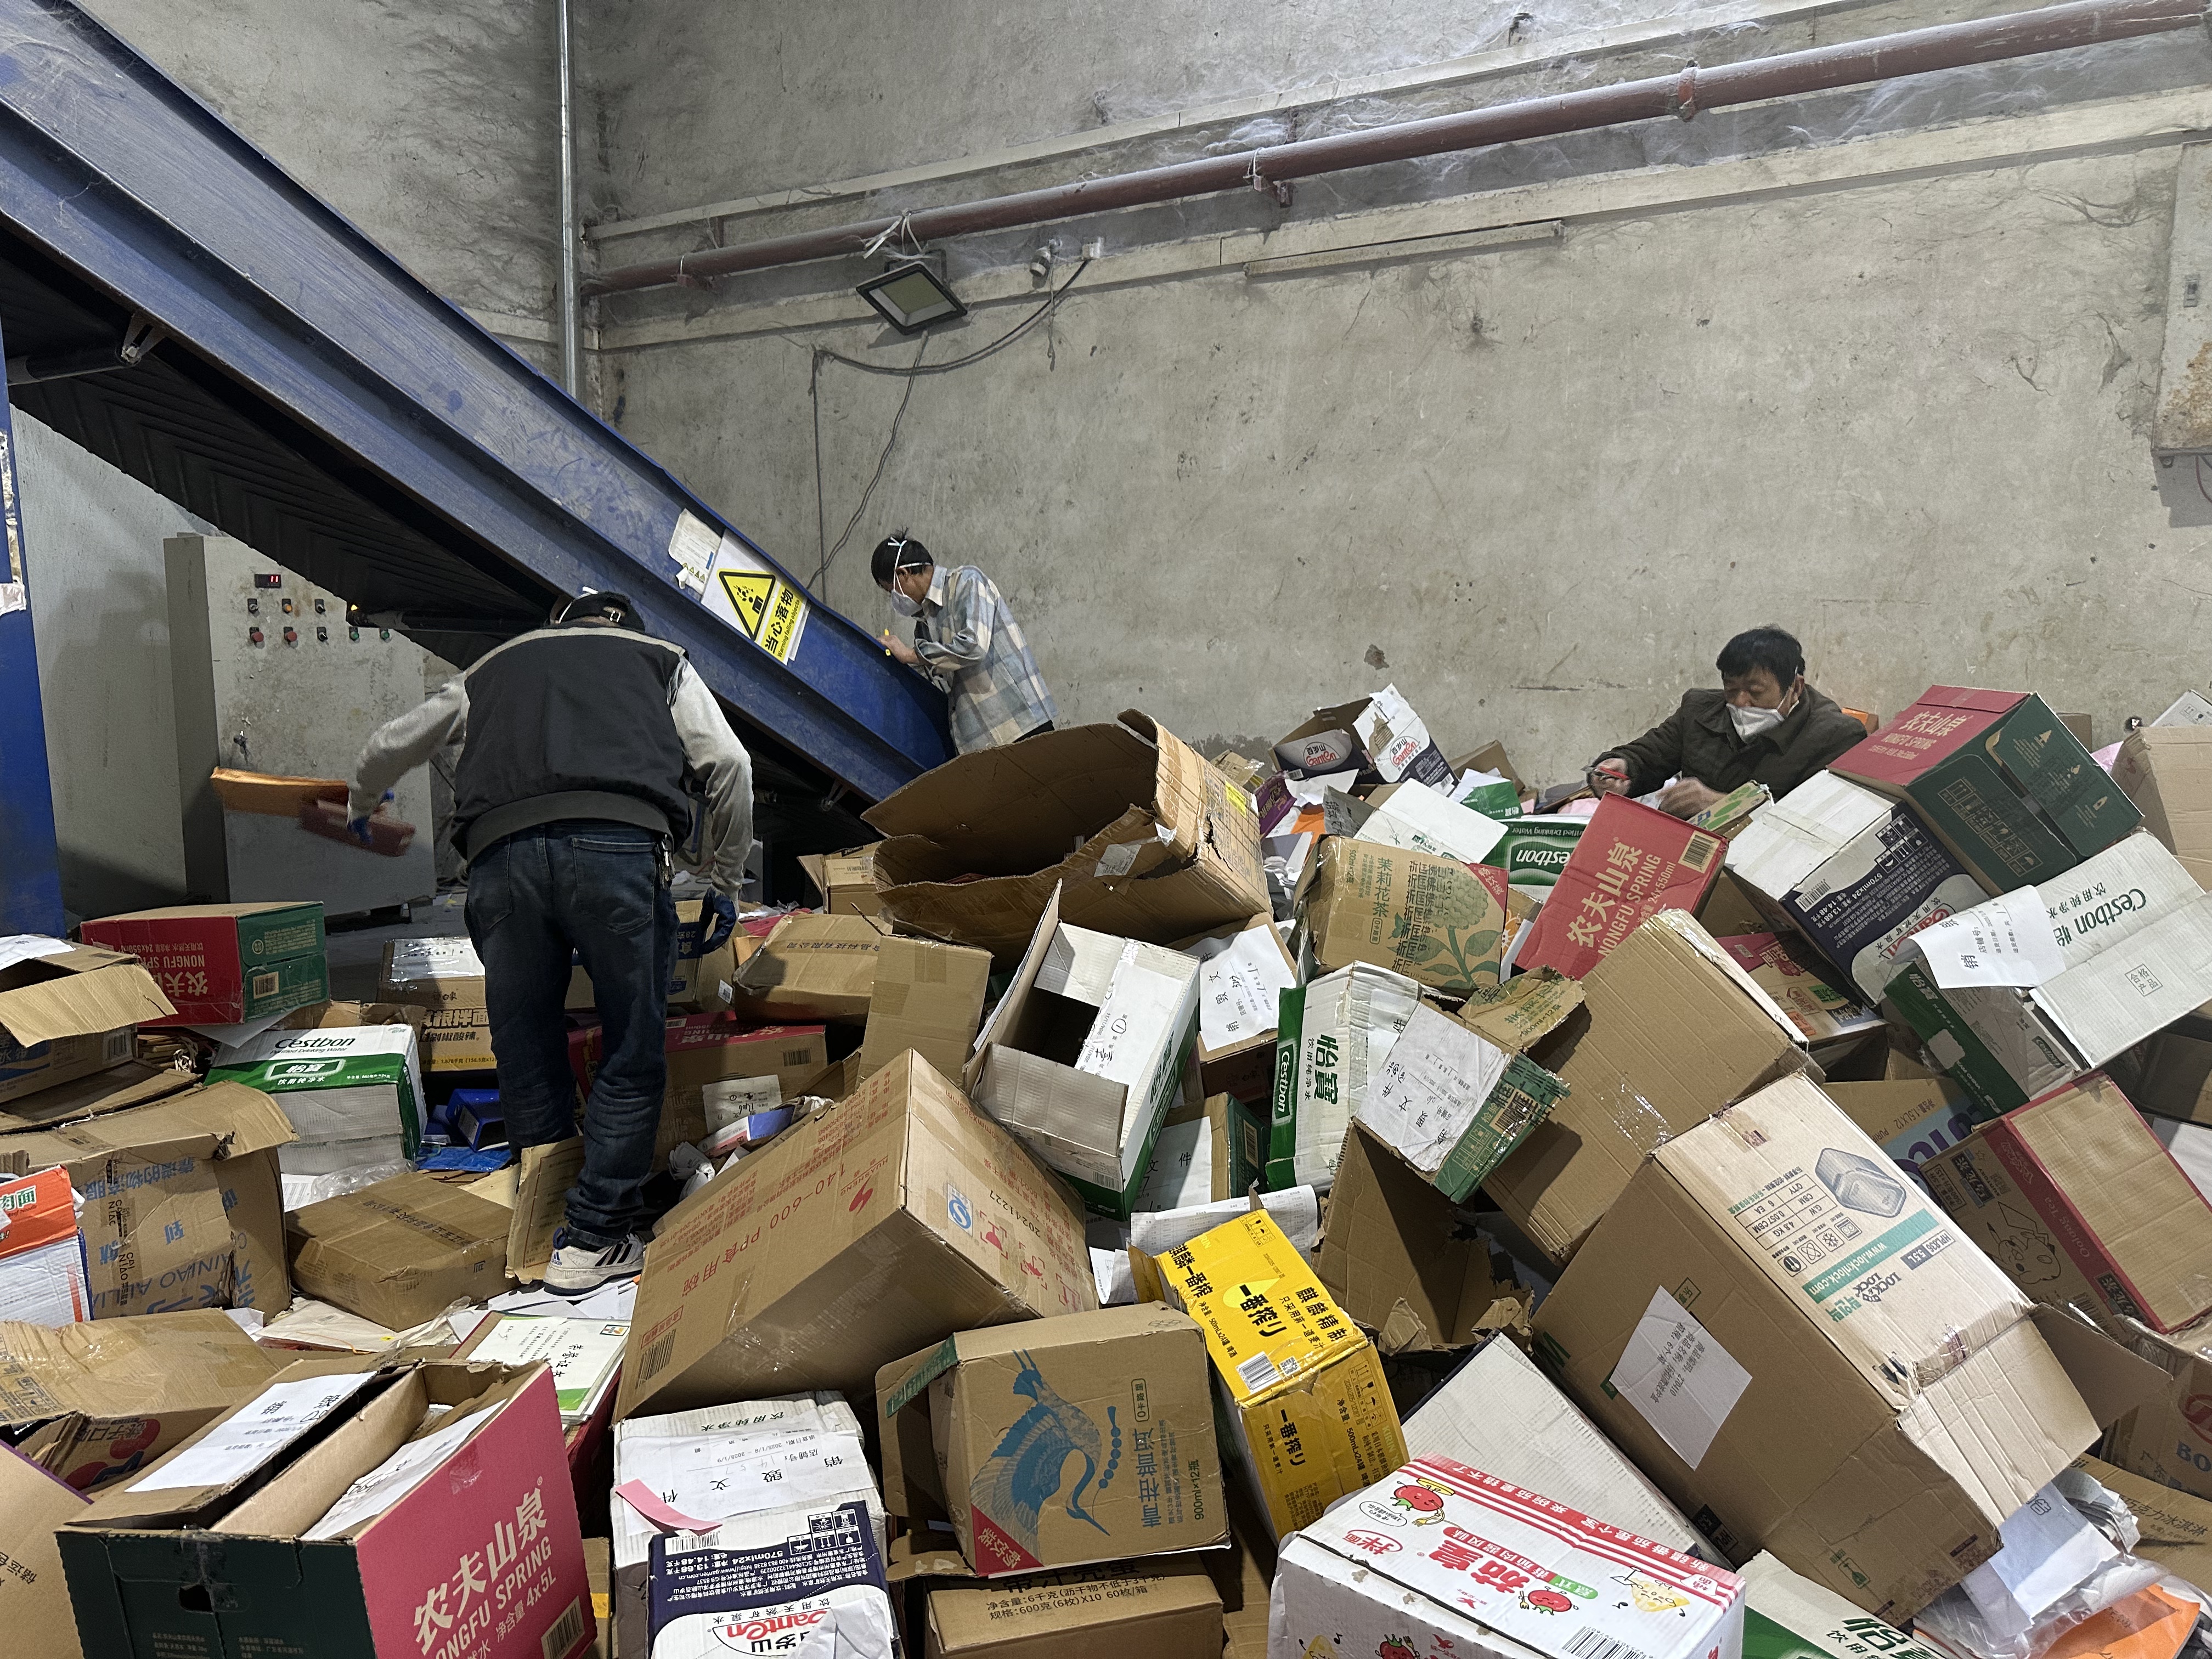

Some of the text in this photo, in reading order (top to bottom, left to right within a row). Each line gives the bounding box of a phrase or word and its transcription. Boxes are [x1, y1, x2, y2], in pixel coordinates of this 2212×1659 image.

[765, 588, 793, 653] 当心落物
[777, 599, 800, 658] Warning falling objects
[1897, 710, 1973, 734] 农夫山泉
[1306, 749, 1336, 766] Ganten
[1392, 741, 1418, 766] Ganten
[1511, 826, 1561, 837] Drinking Water
[1372, 857, 1393, 918] 茉莉花茶
[1478, 867, 1504, 896] 畅饮装
[1561, 836, 1645, 951] 农夫山泉
[1646, 860, 1678, 904] 24x550ml
[1596, 851, 1662, 958] NONGFU SPRING
[1810, 899, 1837, 923] 14.48千克
[1815, 905, 1842, 928] 13.68千克
[2046, 882, 2106, 919] 饮用纯净水
[1874, 896, 1941, 951] 饮用天然矿泉水
[154, 943, 170, 952] 净含量
[163, 955, 204, 968] NONGFU
[172, 941, 203, 951] 饮用天然水
[277, 1077, 325, 1085] 饮用纯净水
[1301, 1037, 1318, 1101] 饮用纯净水
[1310, 1034, 1345, 1105] 怡寶
[838, 1155, 890, 1198] HUASHENG
[1954, 1155, 1988, 1200] 乌龙茶
[1977, 1166, 2000, 1198] SUNTORY
[1752, 1192, 1813, 1233] CBM 0.057 CBM
[1753, 1204, 1765, 1216] EA
[1767, 1199, 1774, 1207] 6
[1772, 1203, 1822, 1237] G.W 4.8 KG
[160, 1219, 186, 1246] 到
[677, 1161, 847, 1299] 140-600 PP食用碗
[1925, 1232, 1951, 1255] HPL836
[2042, 1194, 2091, 1259] Oolong Tea
[1808, 1241, 1887, 1297] www.locknlock.com
[1853, 1272, 1881, 1294] LOCK
[1871, 1272, 1900, 1295] LOCK
[1278, 1295, 1325, 1351] 只采用第一道麦汁
[1825, 1291, 1861, 1323] 락앤락
[1198, 1300, 1214, 1319] 净含量:
[1224, 1344, 1238, 1358] 啤酒
[1656, 1321, 1686, 1365] 箱规: 6个/箱
[1649, 1330, 1696, 1404] 商品名称: 乐扣微波炉盒
[1681, 1340, 1706, 1375] 商品编码:
[702, 1411, 785, 1432] 饮用纯净水
[1335, 1397, 1352, 1425] 净含量:
[783, 1447, 819, 1464] 店铺号:
[1260, 1423, 1286, 1475] 只采用第一道麦汁
[1380, 1425, 1397, 1453] KIRIN
[1132, 1427, 1161, 1528] 青柑普洱
[1449, 1459, 1711, 1575] 新疆番茄是个宝 来碗茄皇错不了
[979, 1527, 1023, 1569] 畅饮装
[1345, 1525, 1393, 1559] 拌面
[414, 1486, 549, 1656] 农夫山泉
[495, 1536, 552, 1610] SPRING
[665, 1554, 708, 1568] 14.48千克
[665, 1550, 783, 1575] 570mlx24 净重: 13.68千克
[678, 1564, 752, 1581] http://www.ganten.com.cn
[1425, 1534, 1532, 1601] 茄皇
[1449, 1527, 1595, 1599] 意式 番茄肉酱风味
[495, 1566, 556, 1643] 净含量 4x5L
[1105, 1585, 1148, 1599] 60枚/箱
[711, 1597, 830, 1624] 饮用天然矿泉水
